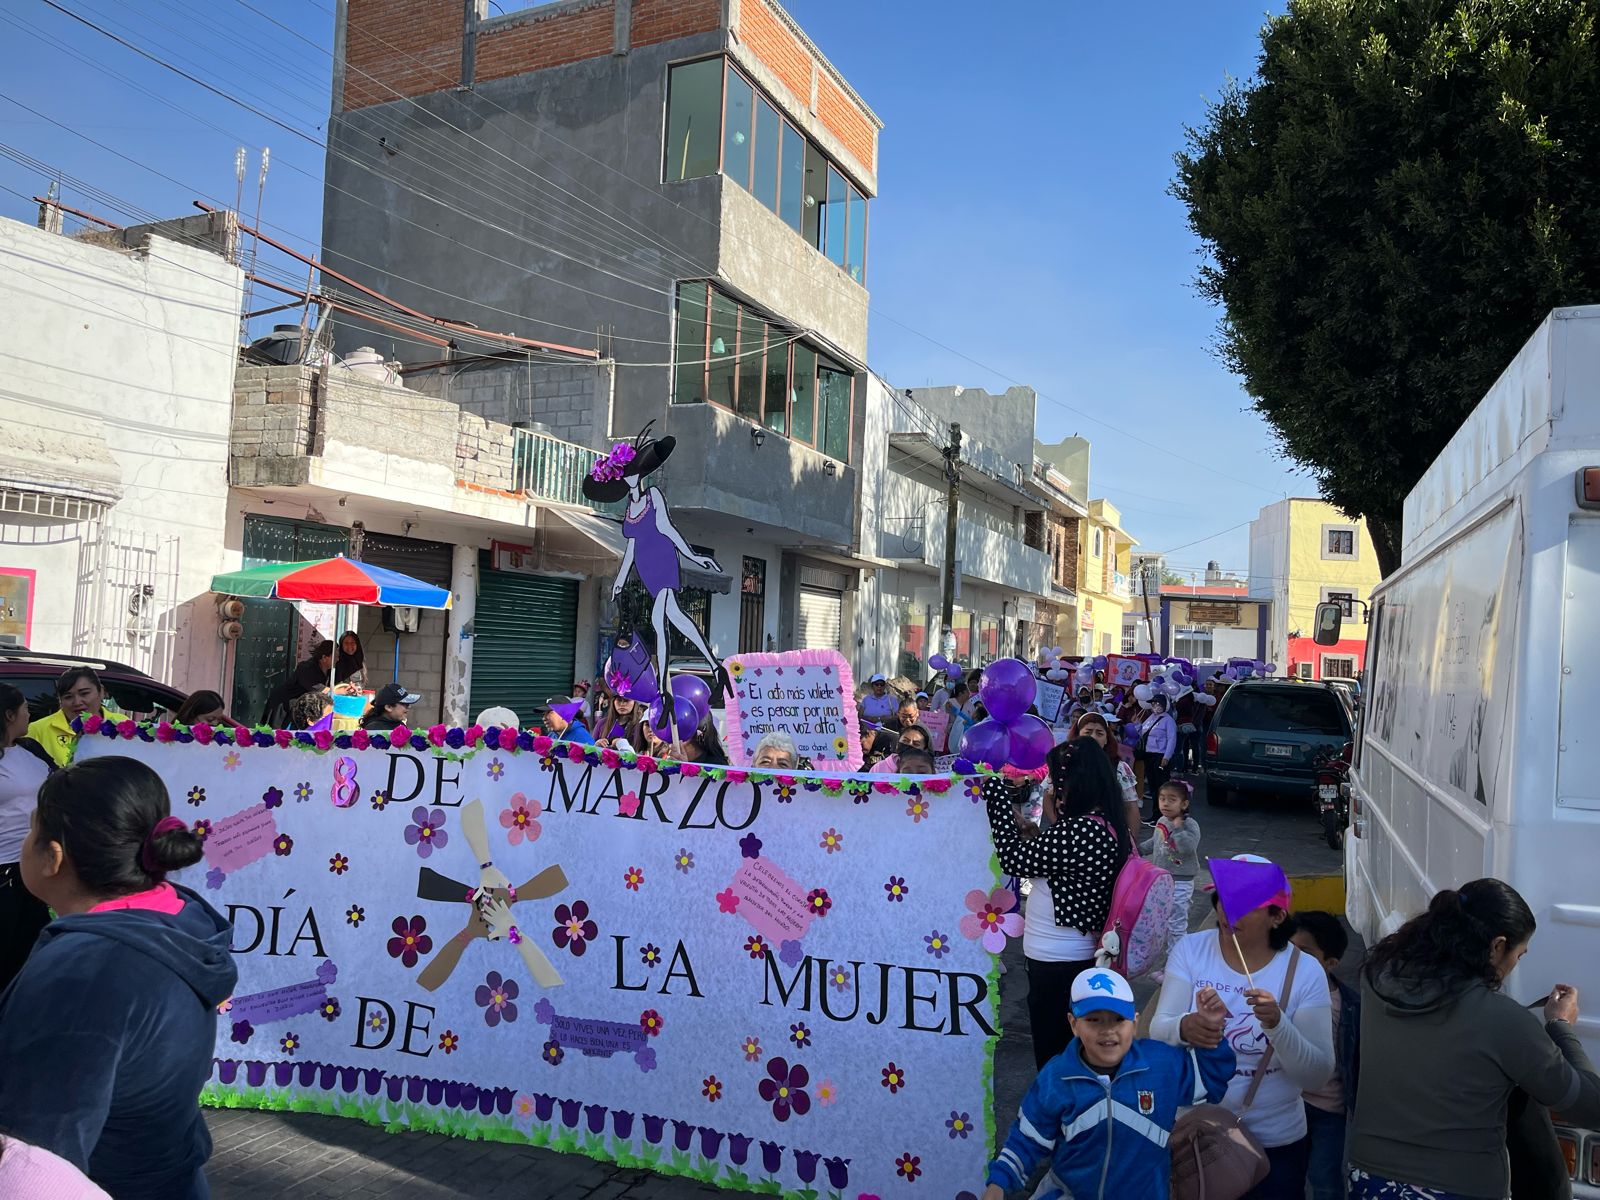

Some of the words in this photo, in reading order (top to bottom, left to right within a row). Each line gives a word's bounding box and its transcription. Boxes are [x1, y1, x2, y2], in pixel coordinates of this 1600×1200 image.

[787, 686, 805, 700] más
[751, 706, 764, 717] es
[768, 706, 799, 721] pensar
[803, 706, 821, 721] por
[823, 706, 839, 717] una
[750, 721, 774, 734] misma
[777, 723, 790, 734] en
[331, 757, 360, 808] 8
[386, 753, 465, 807] DE
[542, 762, 762, 831] MARZO
[224, 888, 329, 957] DÍA
[610, 934, 705, 998] LA
[758, 950, 1001, 1037] MUJER
[1216, 982, 1231, 993] DE
[350, 996, 436, 1058] DE
[573, 1021, 594, 1035] VIVES
[597, 1025, 610, 1036] UNA
[628, 1030, 647, 1042] PERO
[570, 1034, 588, 1045] HACES
